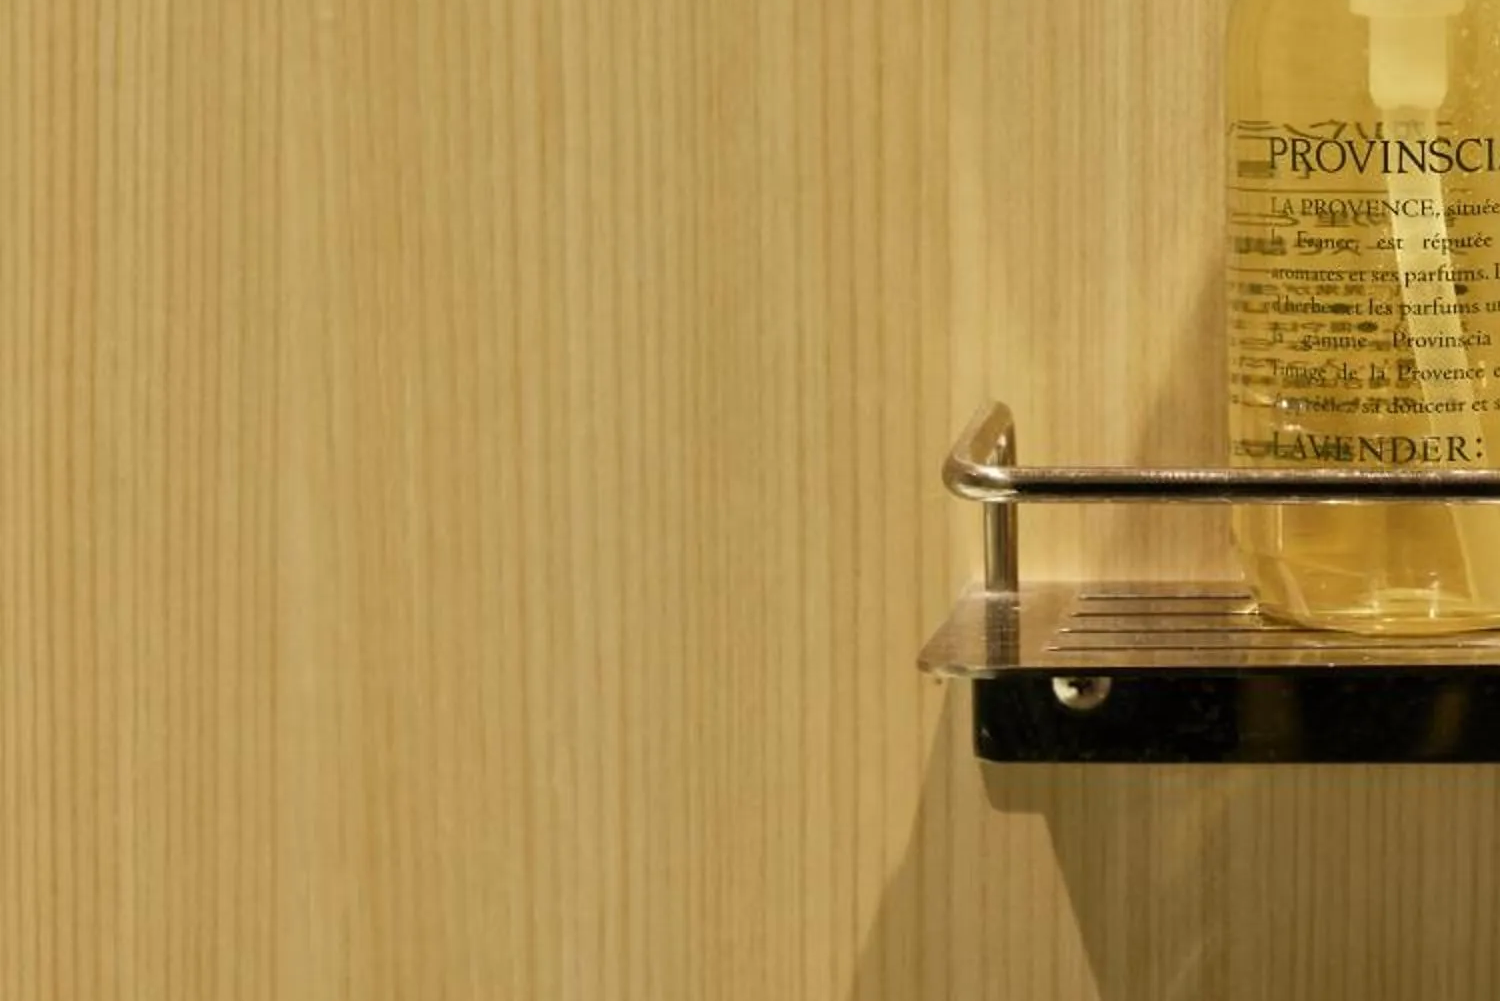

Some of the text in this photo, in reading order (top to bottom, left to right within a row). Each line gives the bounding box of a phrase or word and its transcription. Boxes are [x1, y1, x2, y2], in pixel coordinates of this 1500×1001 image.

[1271, 197, 1295, 215] LA
[1301, 198, 1441, 219] PROVENCE,
[1447, 198, 1500, 217] située
[1377, 237, 1403, 251] est
[1422, 233, 1492, 256] réputée
[1271, 267, 1343, 282] aromates
[1350, 269, 1367, 282] et
[1371, 270, 1399, 283] ses
[1405, 263, 1489, 287] parfums.
[1271, 299, 1338, 316] d'herbe
[1369, 299, 1392, 316] les
[1400, 297, 1480, 321] parfums
[1302, 335, 1367, 352] gamme
[1393, 330, 1491, 349] Provinscia
[1370, 363, 1386, 380] la
[1399, 364, 1484, 382] Provence
[1362, 398, 1381, 415] sa
[1386, 394, 1465, 415] douceur
[1472, 398, 1488, 412] et
